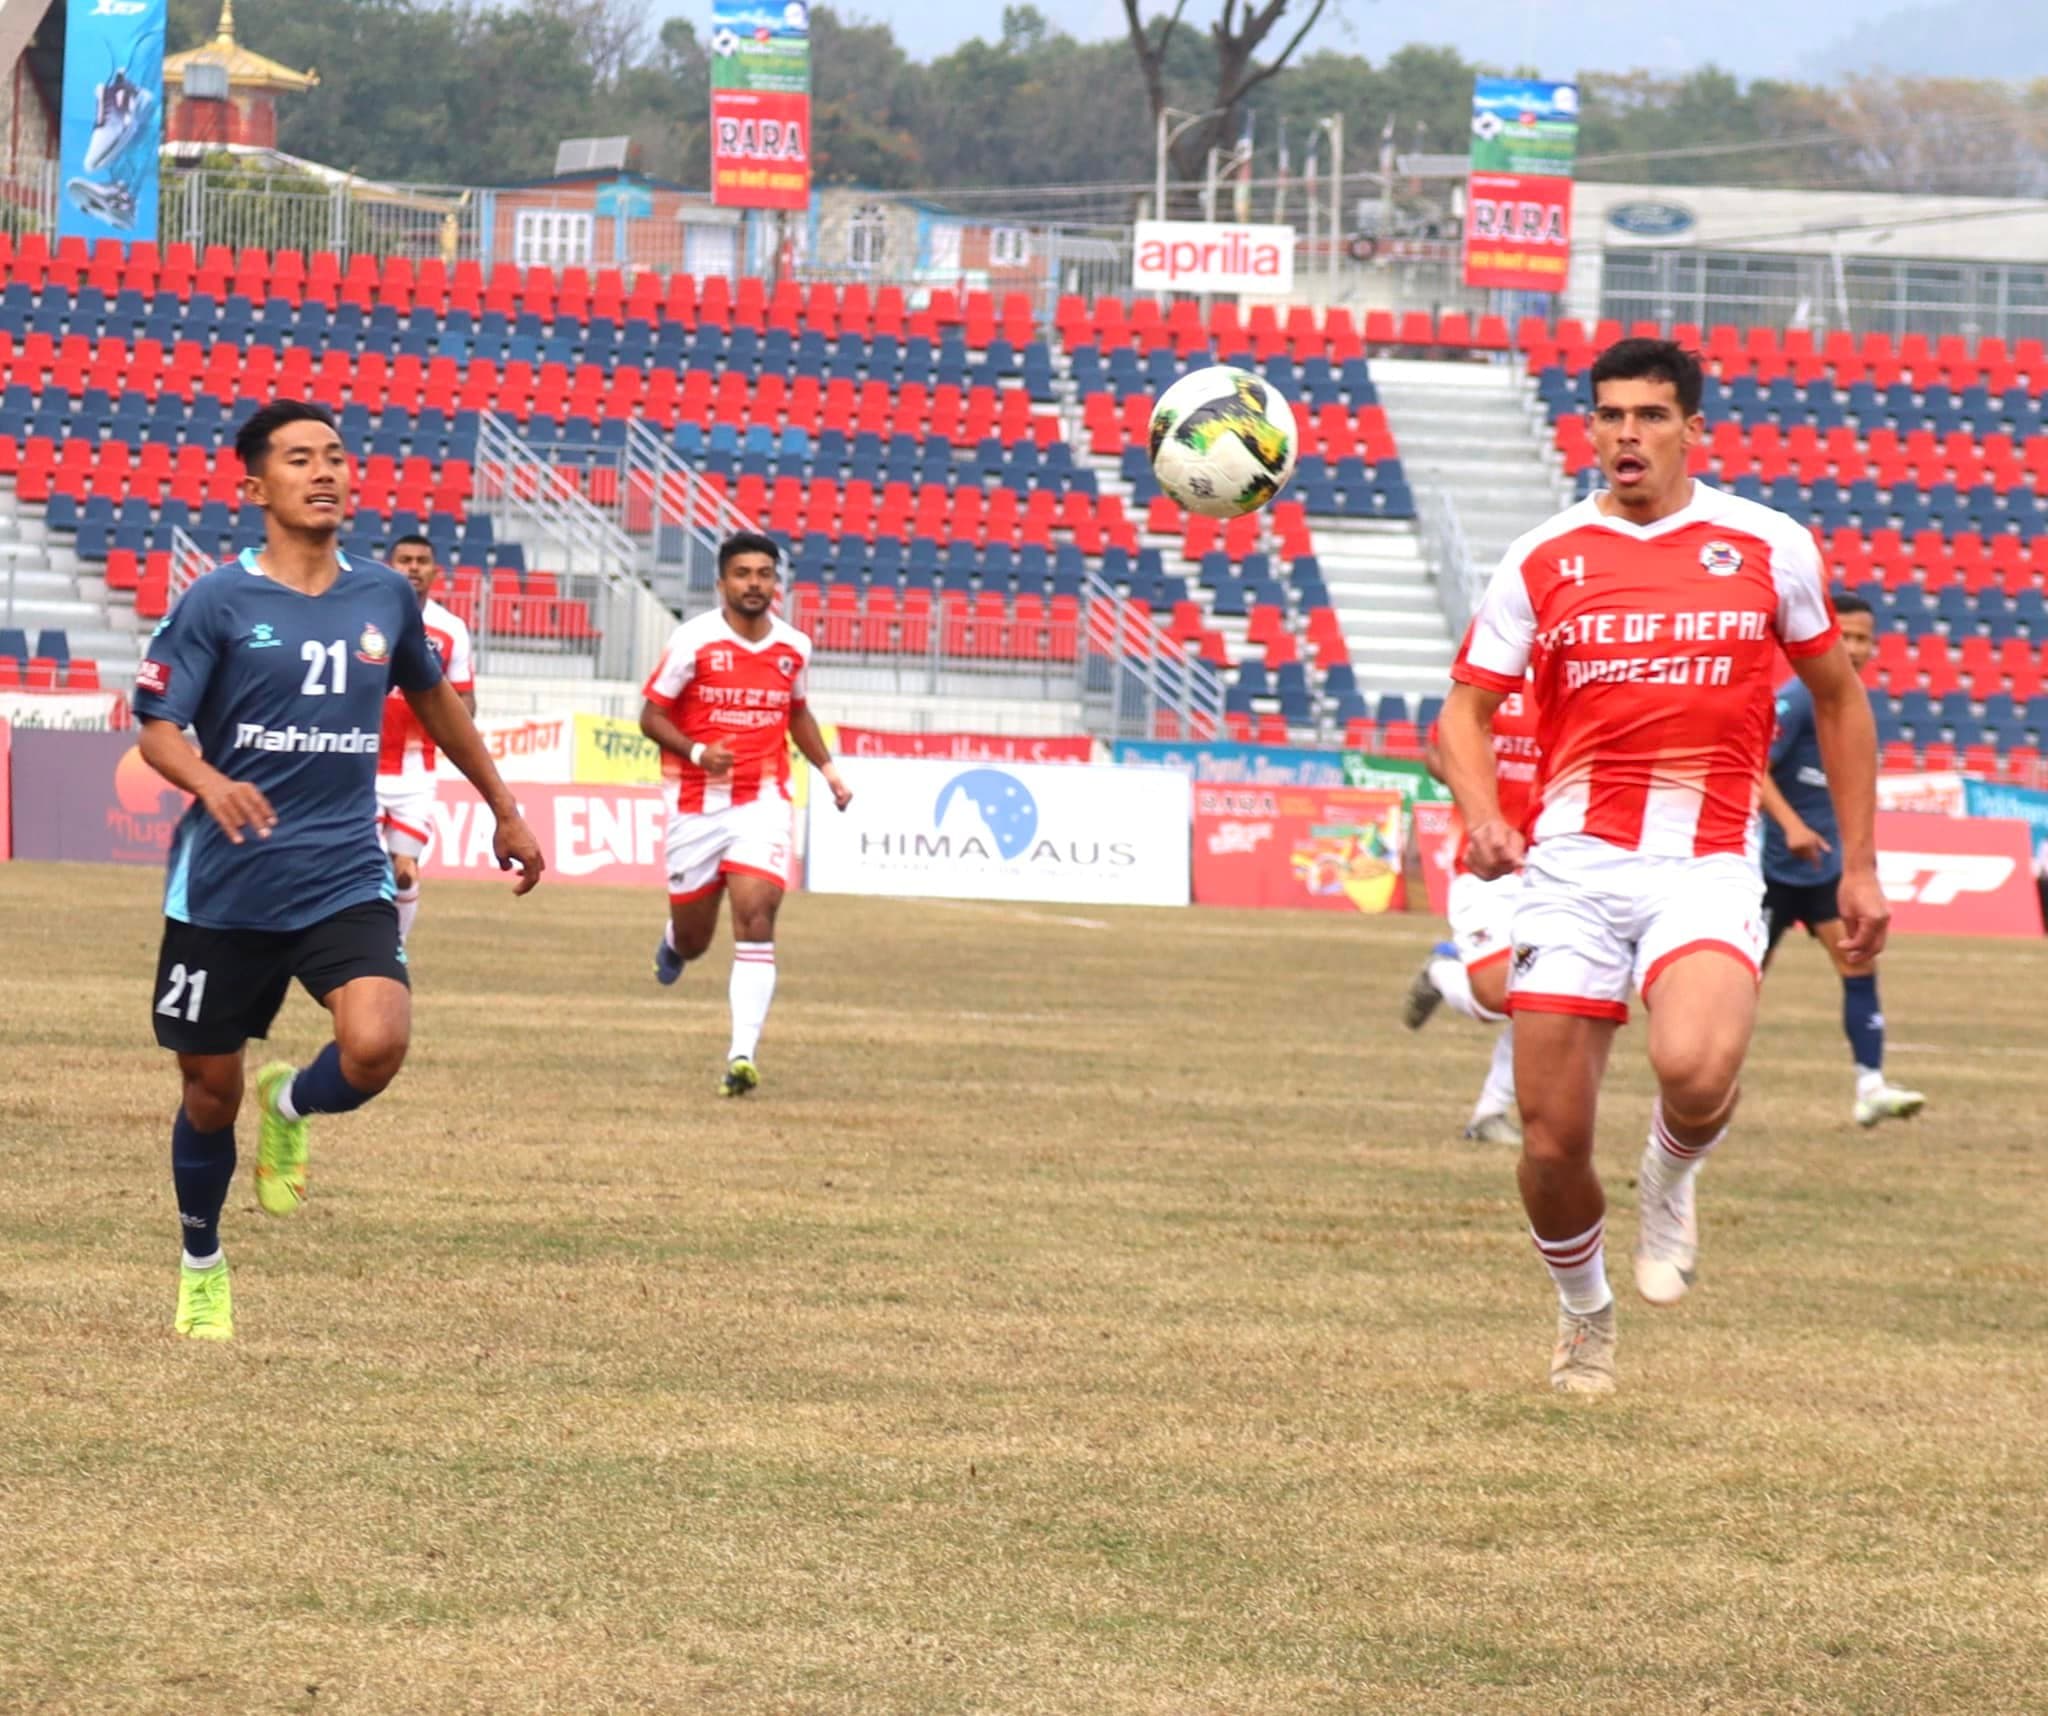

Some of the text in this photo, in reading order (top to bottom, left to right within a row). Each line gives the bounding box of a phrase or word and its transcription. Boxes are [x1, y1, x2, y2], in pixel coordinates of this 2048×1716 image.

[715, 117, 806, 162] RARA
[1470, 198, 1568, 246] RARA
[1139, 231, 1281, 281] aprilia
[1558, 555, 1585, 587] 4
[1623, 613, 1667, 643] OF
[301, 640, 347, 695] 21
[710, 650, 733, 672] 21
[233, 723, 380, 754] Mahindra
[155, 963, 208, 1023] 21
